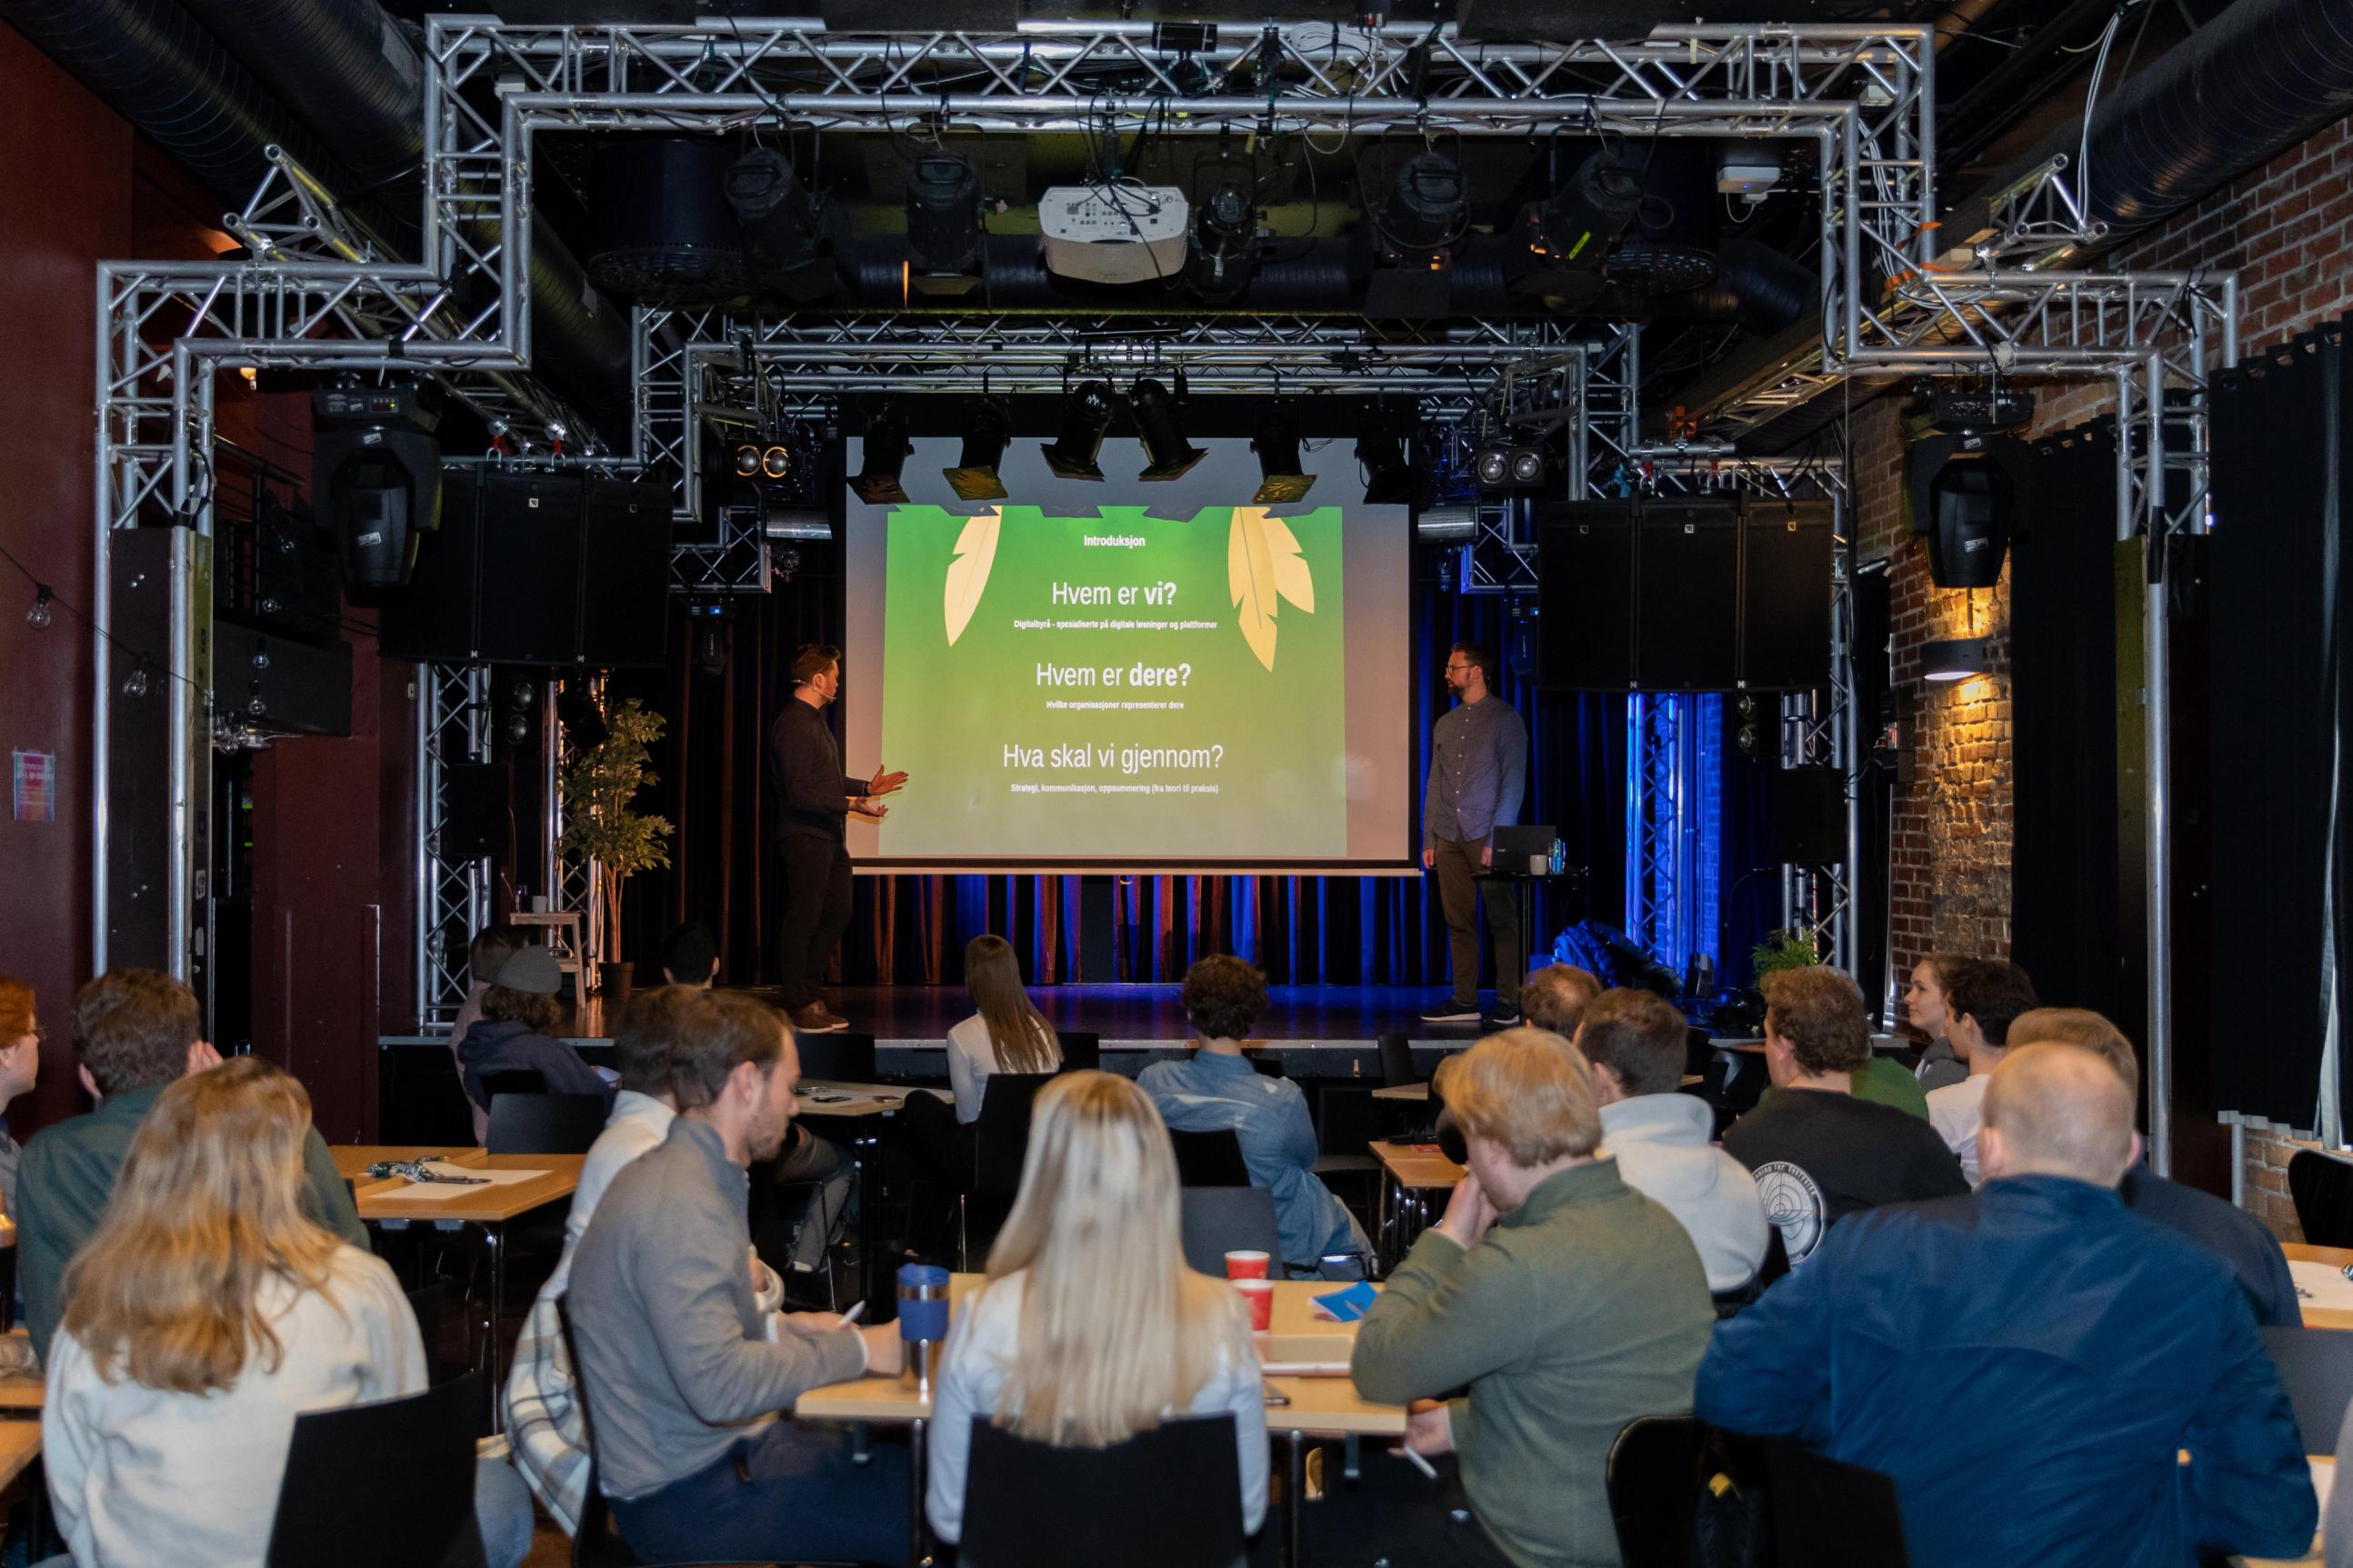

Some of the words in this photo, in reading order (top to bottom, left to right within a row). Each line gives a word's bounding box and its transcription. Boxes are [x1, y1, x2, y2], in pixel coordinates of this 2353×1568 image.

[1084, 534, 1146, 549] Introduksjon
[1052, 582, 1111, 604] Hvem
[1117, 586, 1138, 604] er
[1144, 581, 1176, 605] vi?
[1014, 619, 1051, 630] Digitalbyrå
[1056, 619, 1098, 630] spesialiserte
[1099, 619, 1108, 630] på
[1110, 620, 1135, 630] digitale
[1136, 620, 1168, 630] løsninger
[1169, 622, 1178, 630] og
[1179, 621, 1217, 630] plattformer
[1036, 663, 1096, 686] Hvem
[1103, 667, 1124, 686] er
[1129, 662, 1192, 686] dere?
[1046, 701, 1067, 710] Hvilke
[1068, 701, 1120, 711] organisasjoner
[1121, 701, 1167, 711] representerer
[1168, 701, 1185, 710] dere
[1003, 744, 1045, 768] Hva
[1050, 743, 1091, 768] skal
[1098, 743, 1115, 768] vi
[1121, 744, 1224, 774] gjennom?
[1011, 784, 1040, 794] Strategi,
[1041, 784, 1097, 794] kommunikasjon,
[1098, 784, 1150, 794] oppsummering
[1151, 784, 1165, 794] (fra
[1166, 784, 1181, 794] teori
[1190, 784, 1219, 794] praksis)
